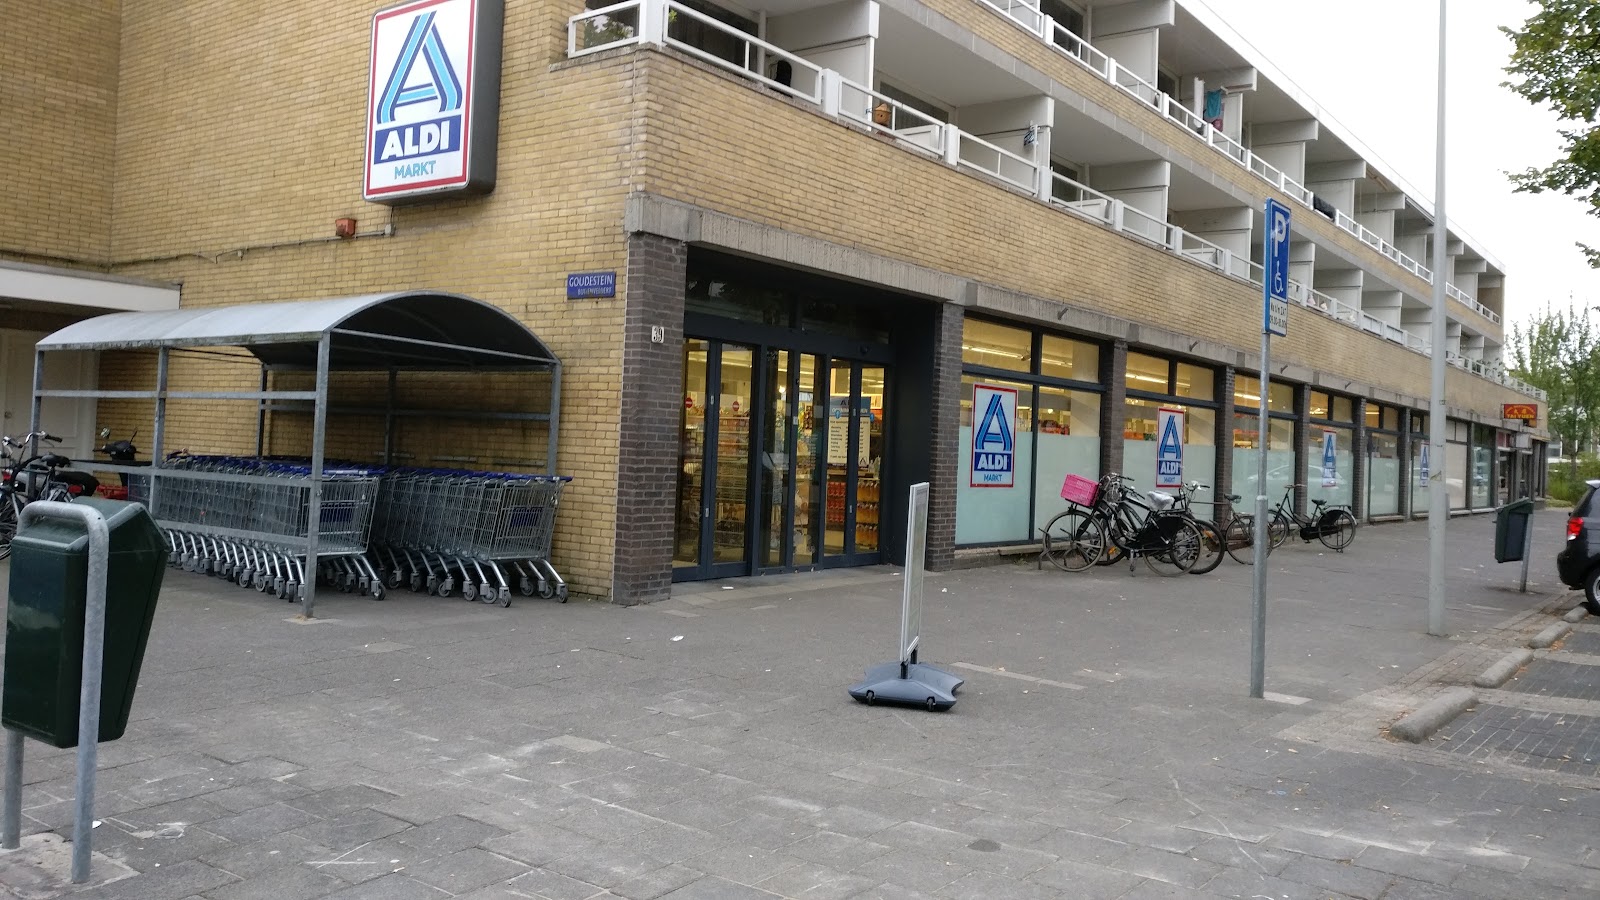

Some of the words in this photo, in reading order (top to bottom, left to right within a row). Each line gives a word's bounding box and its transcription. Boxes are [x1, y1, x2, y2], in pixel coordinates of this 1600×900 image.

[380, 120, 450, 161] ALDI
[394, 160, 436, 179] MARKT
[1274, 211, 1286, 257] P
[569, 275, 612, 287] GOUDESTEIN
[977, 453, 1008, 470] ALDI
[1160, 461, 1179, 474] ALDI
[983, 473, 1003, 482] MARKT
